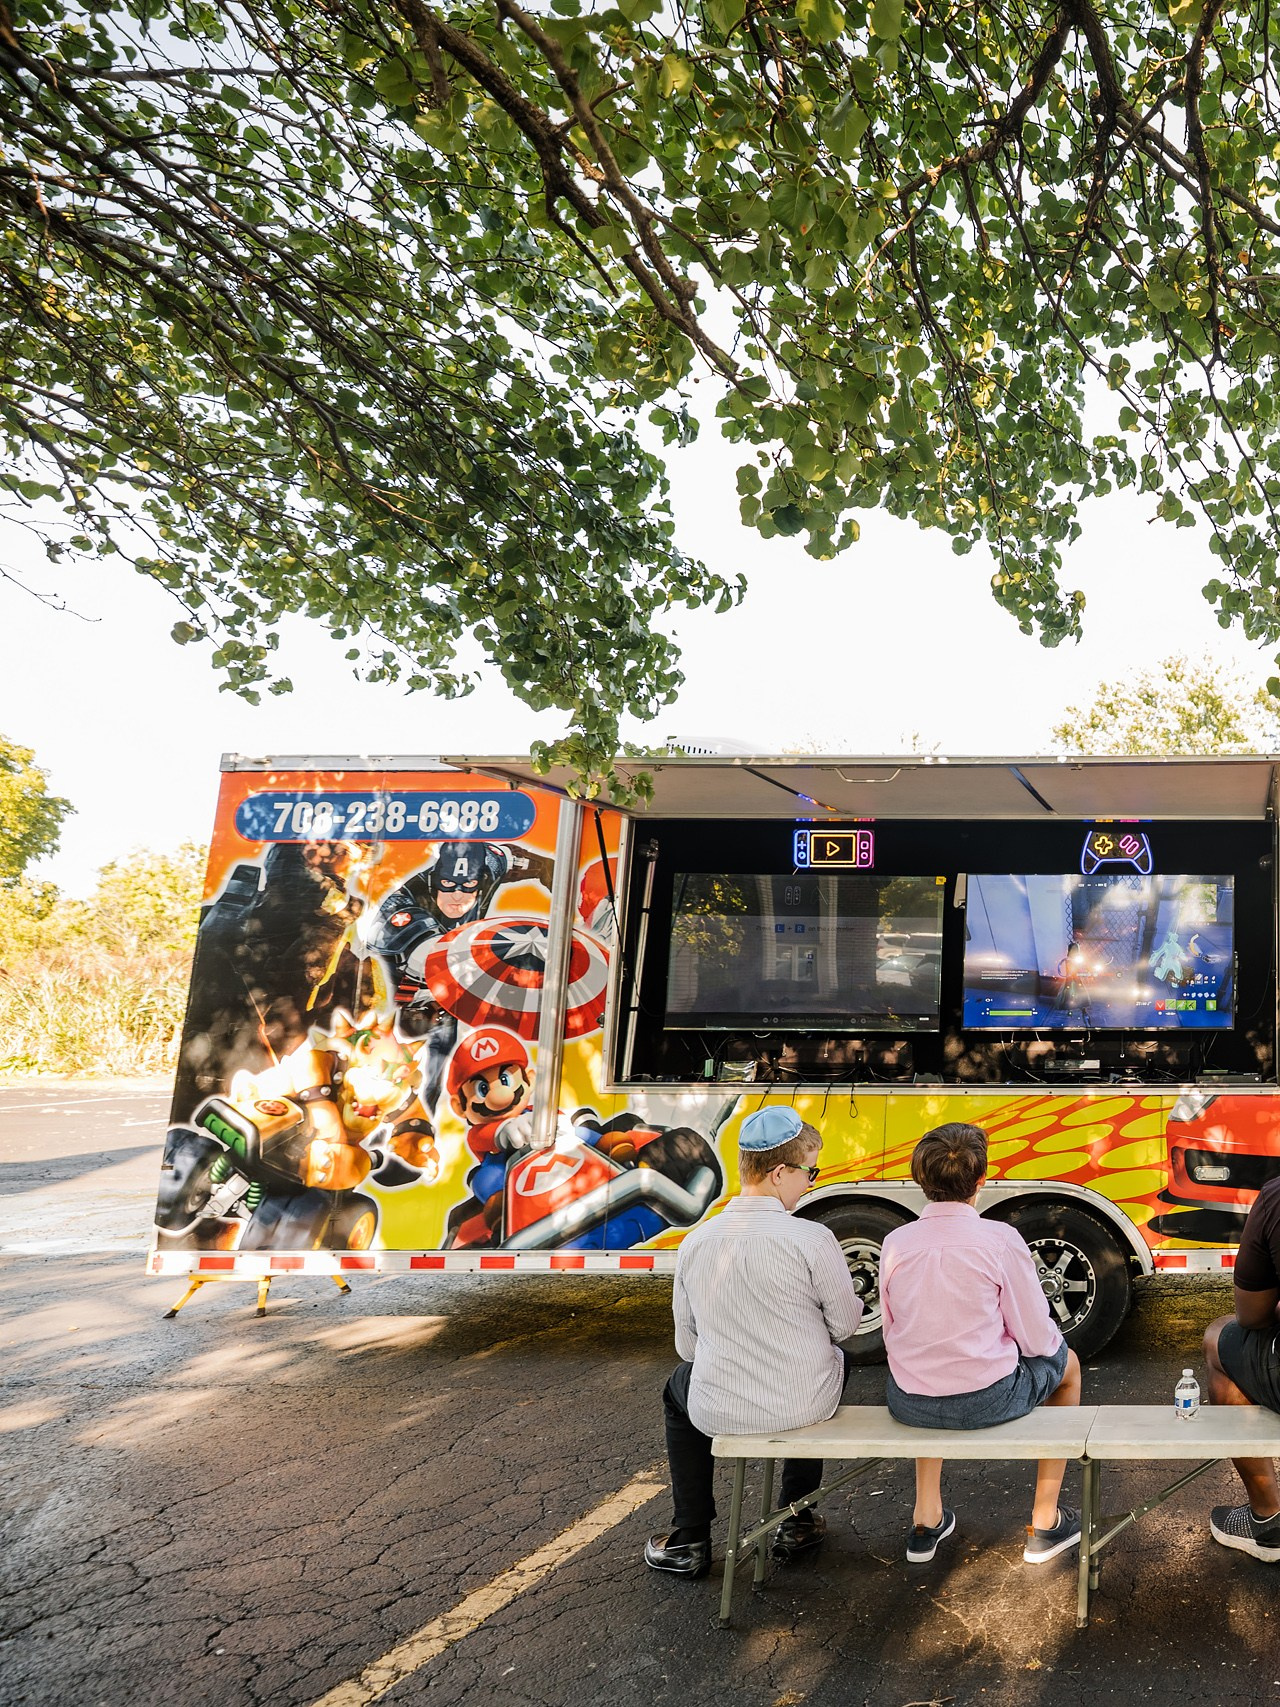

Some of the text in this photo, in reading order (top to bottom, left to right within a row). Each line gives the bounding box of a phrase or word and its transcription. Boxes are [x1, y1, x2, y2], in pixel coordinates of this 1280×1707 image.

[272, 800, 500, 833] 708-238-6988
[452, 857, 469, 877] A
[475, 1039, 497, 1059] M
